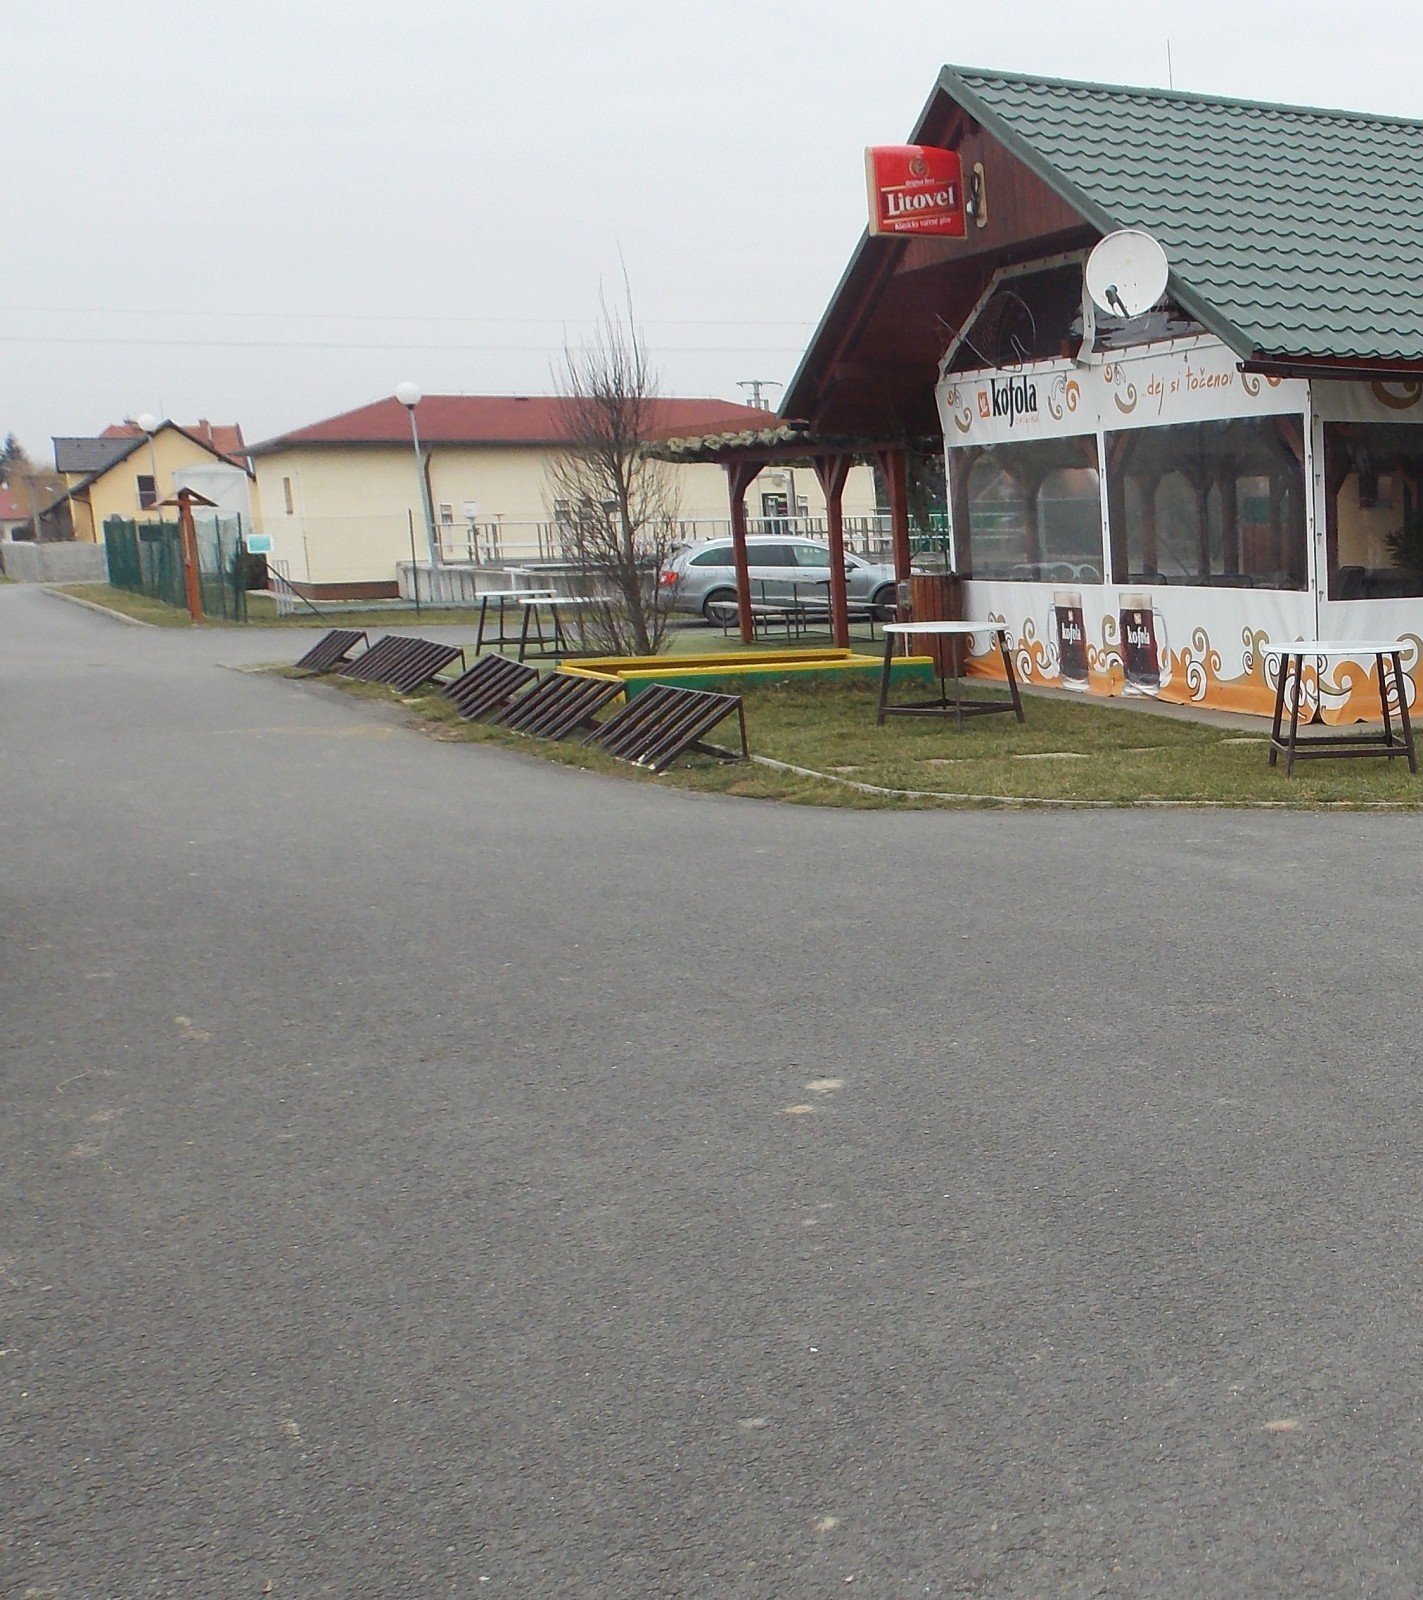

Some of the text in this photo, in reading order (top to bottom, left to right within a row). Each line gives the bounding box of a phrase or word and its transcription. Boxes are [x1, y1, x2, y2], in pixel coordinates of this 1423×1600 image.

[886, 185, 955, 216] Litovel
[1170, 371, 1180, 394] si
[990, 374, 1038, 428] kofola
[1061, 622, 1081, 645] kofola
[1127, 625, 1150, 649] kofola
